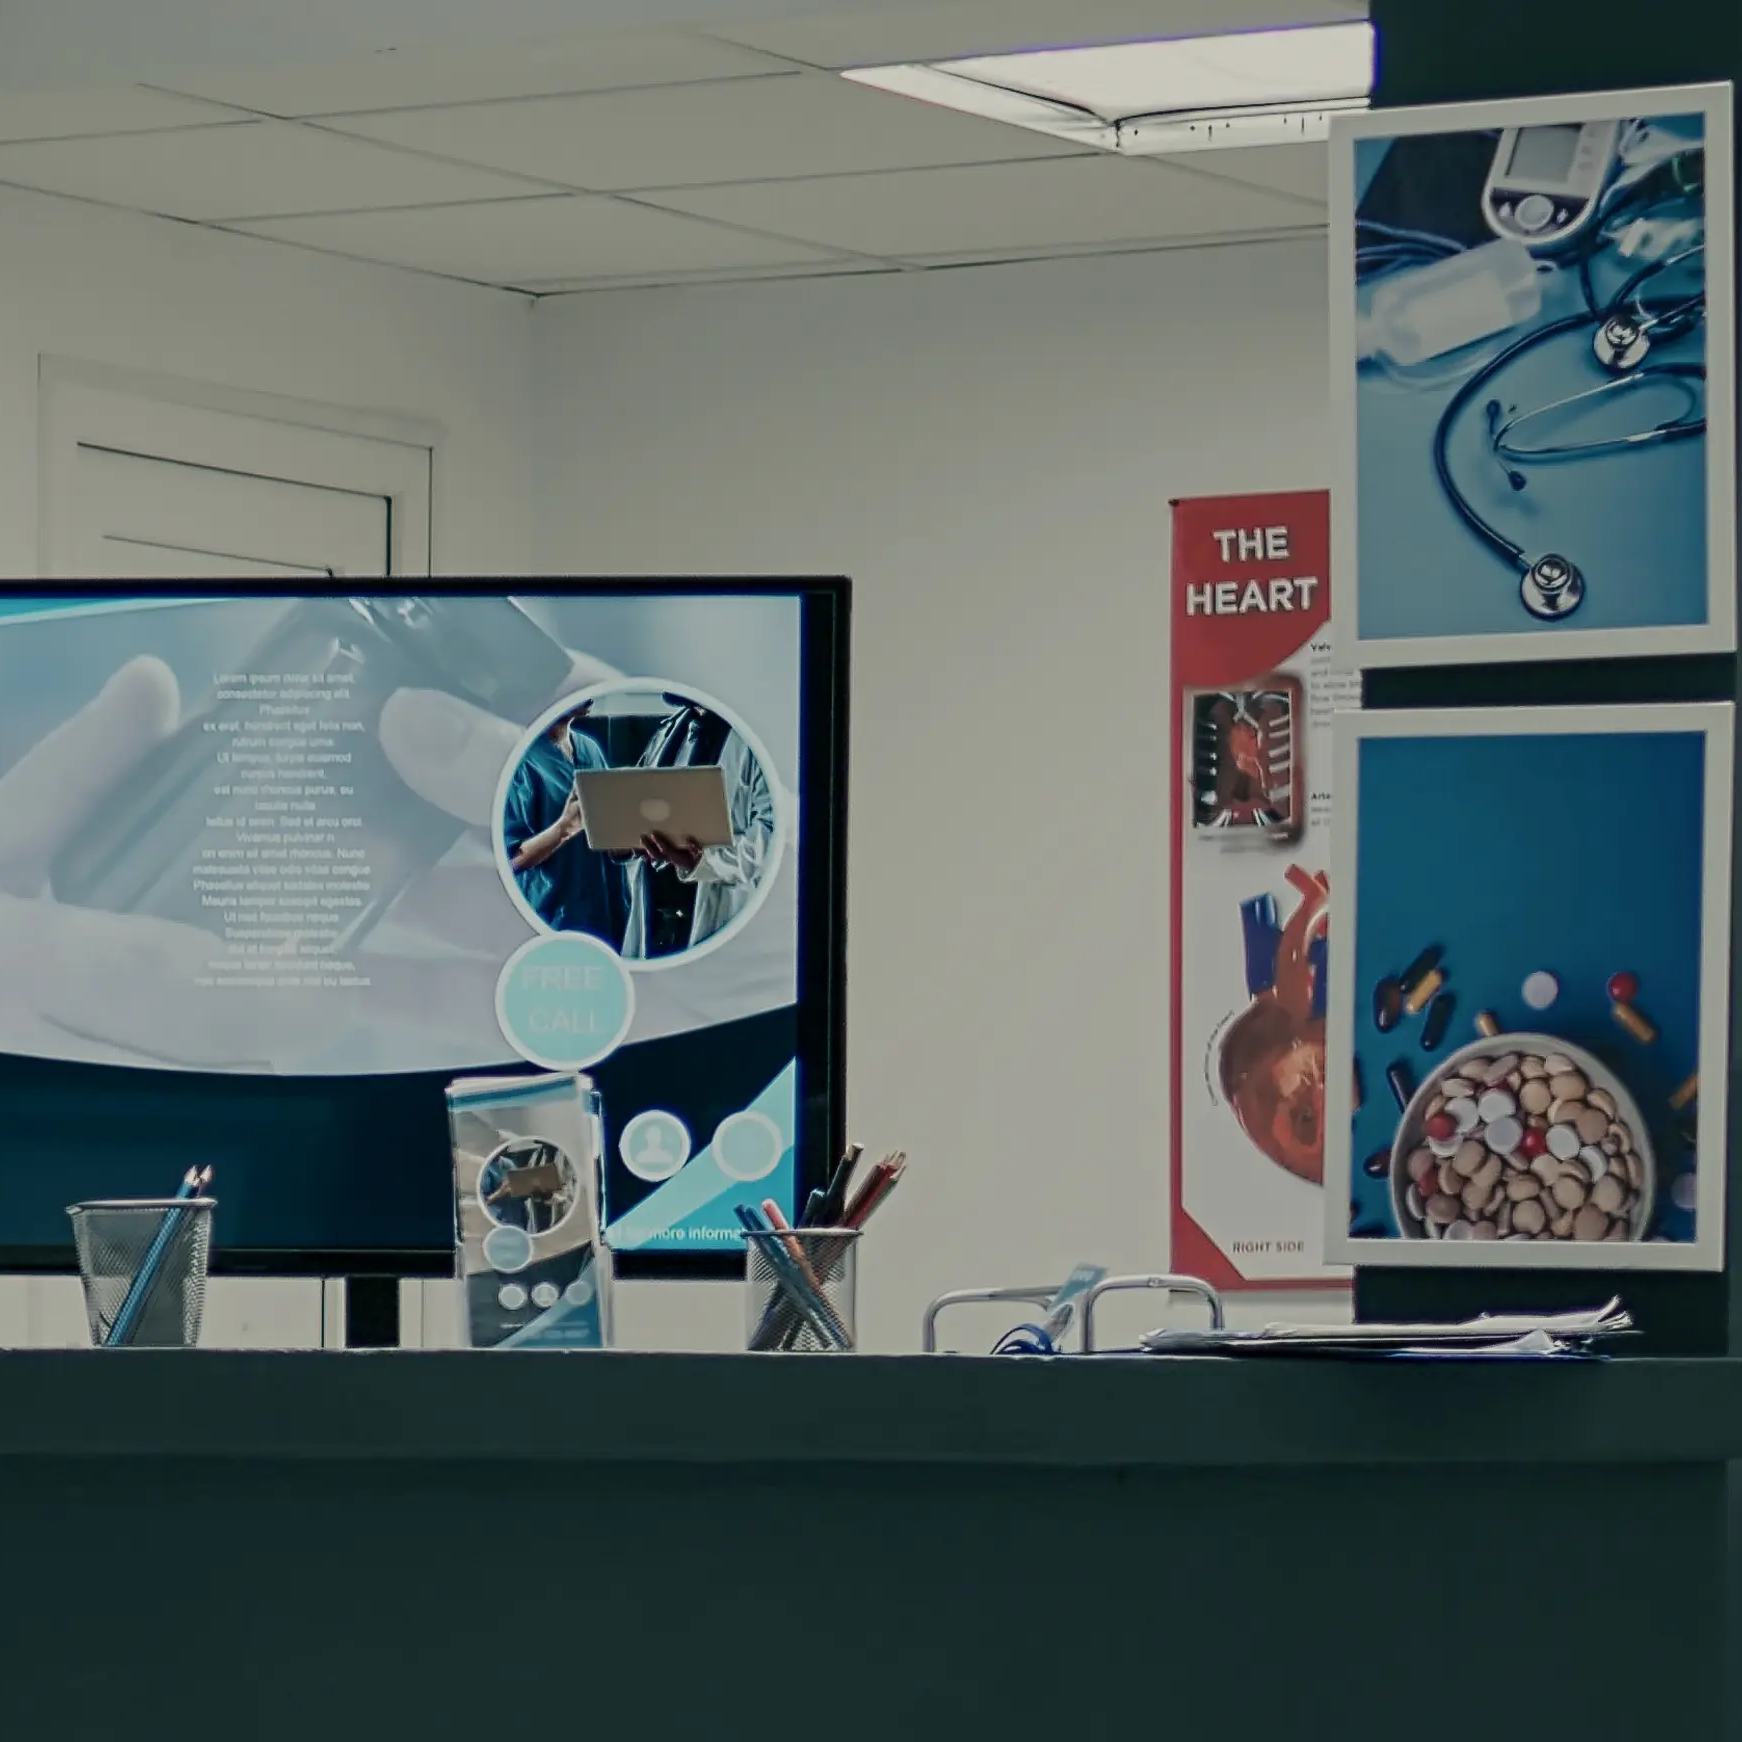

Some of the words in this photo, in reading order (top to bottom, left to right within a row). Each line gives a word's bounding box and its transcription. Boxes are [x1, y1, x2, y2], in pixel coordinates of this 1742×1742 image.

[1212, 526, 1290, 563] THE
[1186, 576, 1319, 616] HEART
[521, 965, 603, 991] FREE
[528, 1006, 608, 1034] CALL
[649, 1228, 685, 1240] more
[689, 1225, 742, 1240] informa
[1232, 1241, 1272, 1253] RIGHT
[1276, 1241, 1304, 1253] SIDE
